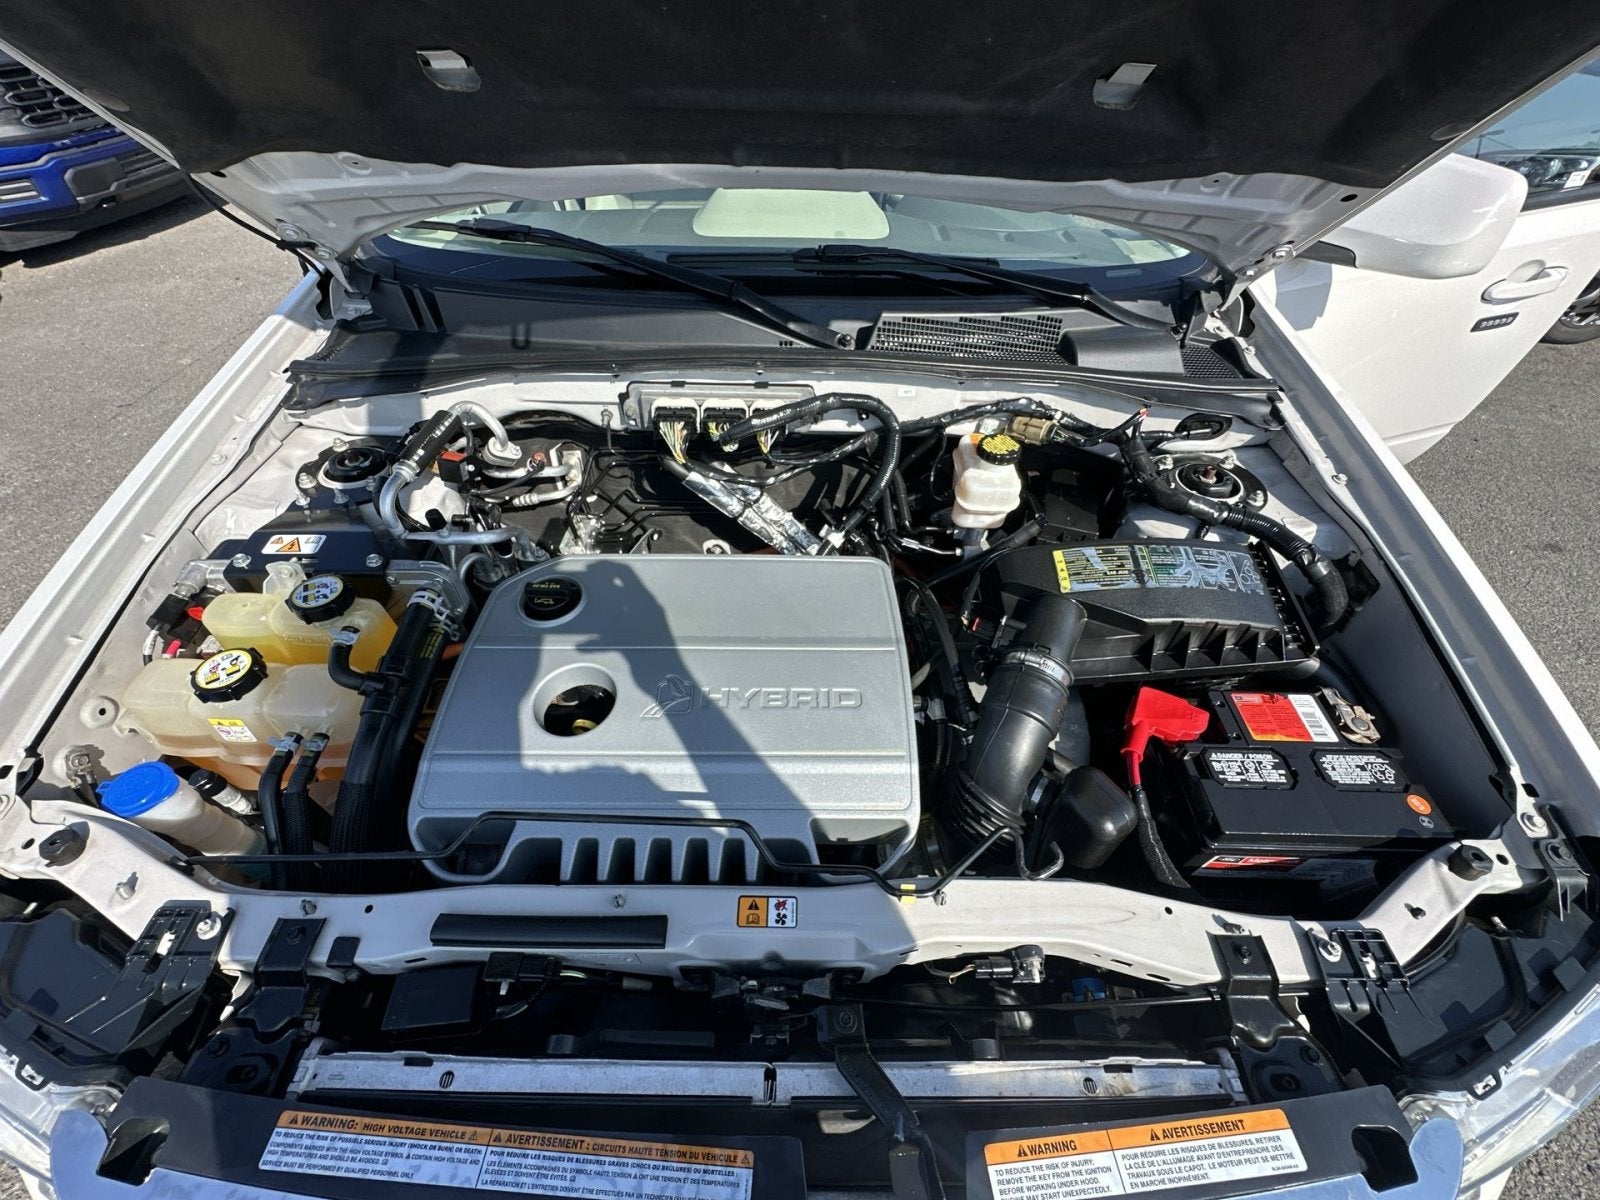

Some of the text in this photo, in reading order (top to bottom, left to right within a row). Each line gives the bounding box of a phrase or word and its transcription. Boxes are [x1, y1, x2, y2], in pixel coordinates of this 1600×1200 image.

[701, 688, 862, 708] HYBRID
[299, 1115, 466, 1139] WARNING: HIGH VOLTAGE VEHICLE
[1160, 1119, 1246, 1139] AVERTISSEMENT
[269, 1141, 304, 1149] COMPONENTS
[337, 1136, 363, 1144] POSSIBLE
[505, 1133, 584, 1149] AVERTISSEMENT
[591, 1142, 626, 1153] CIRCUITS
[628, 1146, 653, 1155] HAUTE
[654, 1148, 687, 1158] TENSION
[688, 1151, 699, 1159] DU
[1026, 1138, 1077, 1156] WARNING
[1121, 1152, 1139, 1161] POUR
[1179, 1144, 1207, 1153] RISQUES
[1254, 1134, 1281, 1144] RETIRER
[278, 1149, 318, 1159] TEMPERATURES
[1156, 1155, 1195, 1166] L'ALLUMAGE
[1195, 1152, 1216, 1161] AVANT
[1216, 1145, 1270, 1158] D'ENTREPRENDRE
[304, 1163, 336, 1171] PERFORMED
[343, 1166, 370, 1174] QUALIFIED
[369, 1169, 400, 1177] PERSONNEL
[575, 1157, 606, 1165] BLESSURES
[702, 1168, 734, 1176] MORTELLES
[1004, 1165, 1030, 1176] REDUCE
[1127, 1170, 1156, 1180] TRAVAUX
[1156, 1167, 1174, 1176] SOUS
[1216, 1158, 1243, 1168] MOTEUR
[1243, 1156, 1260, 1164] PEUT
[1269, 1152, 1295, 1161] METTRE
[997, 1176, 1023, 1186] REMOVE
[1052, 1170, 1070, 1179] FROM
[1084, 1165, 1111, 1175] IGNITION
[1139, 1178, 1167, 1188] MARCHE
[999, 1186, 1024, 1196] BEFORE
[1025, 1181, 1056, 1193] WORKING
[1057, 1179, 1079, 1188] UNDER
[1040, 1191, 1060, 1200] START
